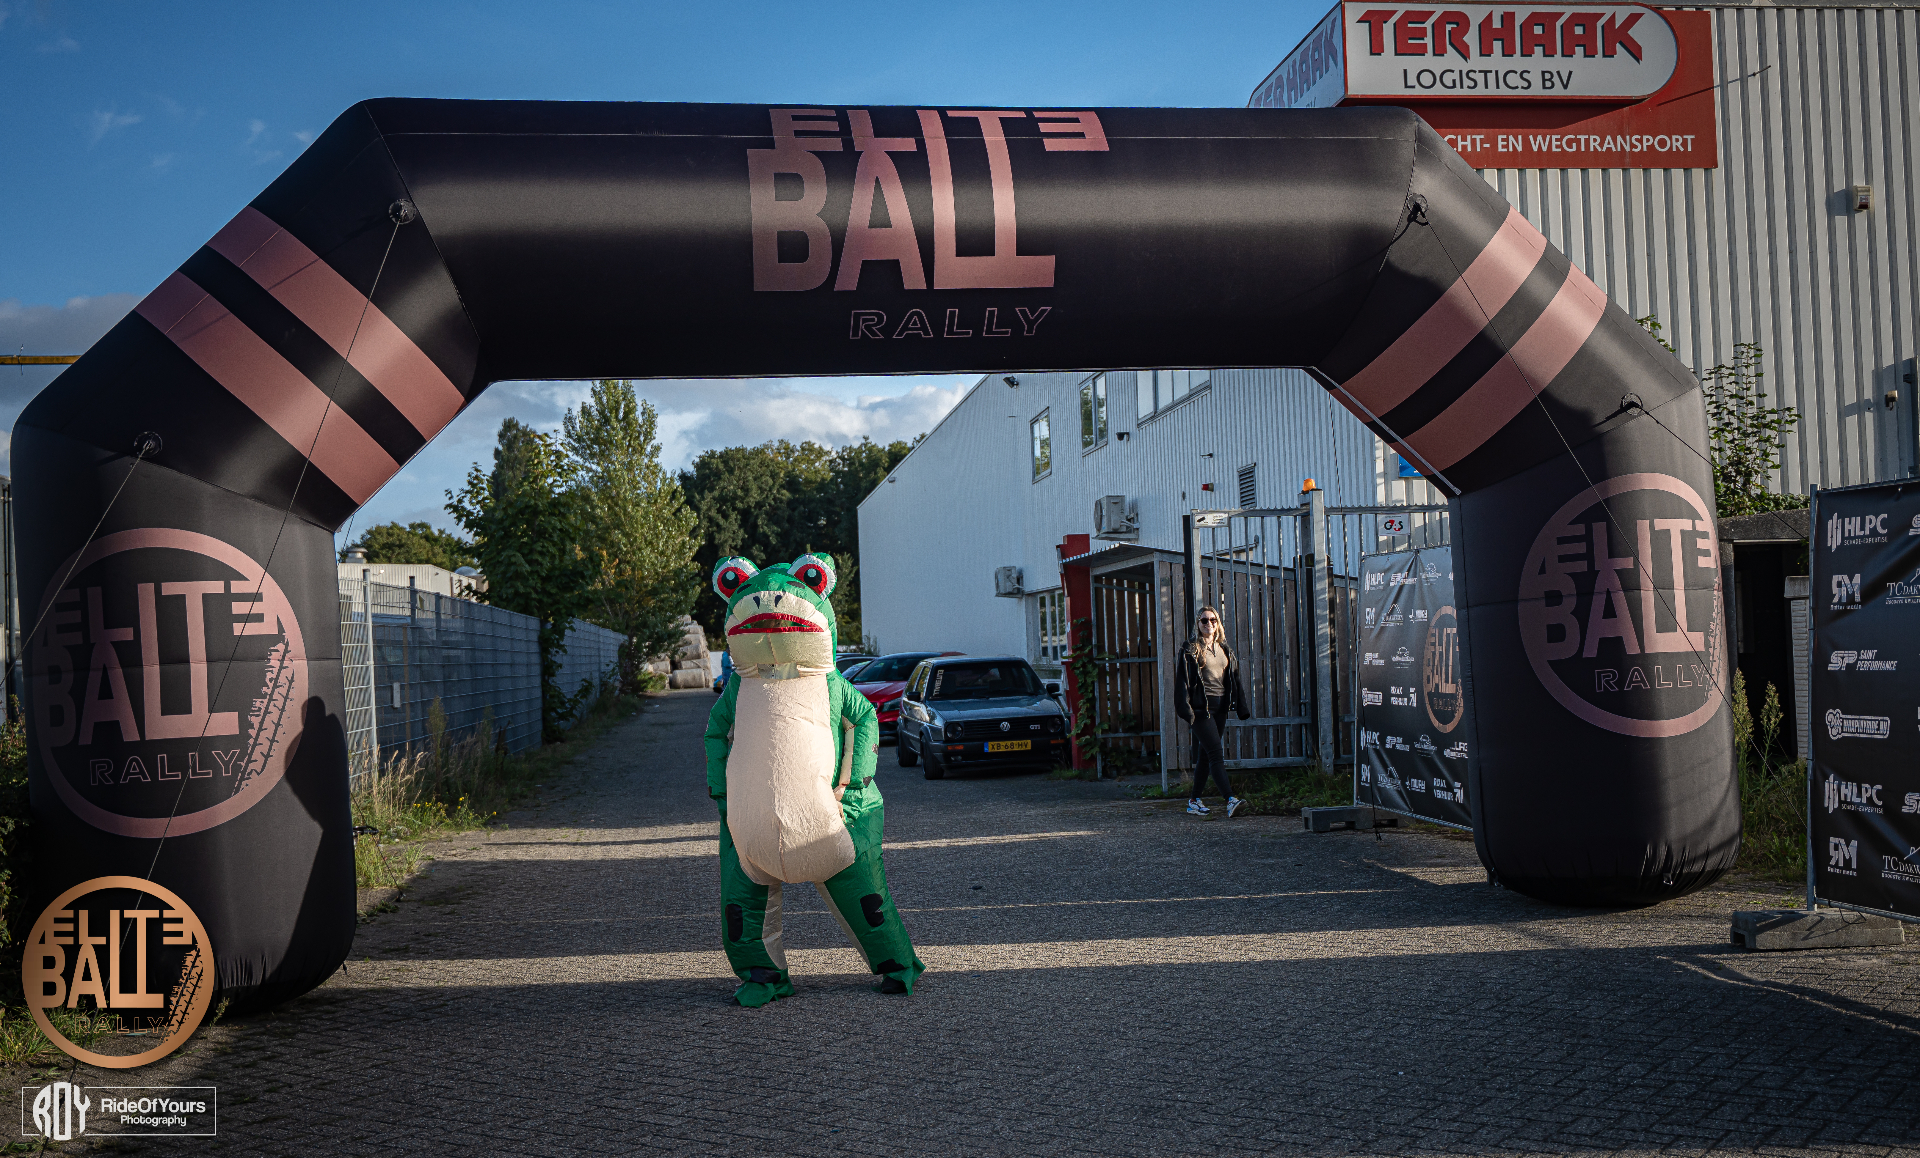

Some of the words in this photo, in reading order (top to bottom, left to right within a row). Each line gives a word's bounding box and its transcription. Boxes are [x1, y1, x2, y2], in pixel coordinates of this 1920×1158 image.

[1403, 69, 1532, 90] LOGISTICS
[1541, 69, 1573, 90] BV
[1498, 134, 1522, 152] EN
[1529, 134, 1696, 152] WEGTRANSPORT
[850, 306, 1052, 339] RALLY
[1844, 513, 1888, 537] HLPC
[1595, 664, 1708, 692] RALLY
[90, 750, 240, 785] RALLY
[1840, 781, 1883, 806] HLPC
